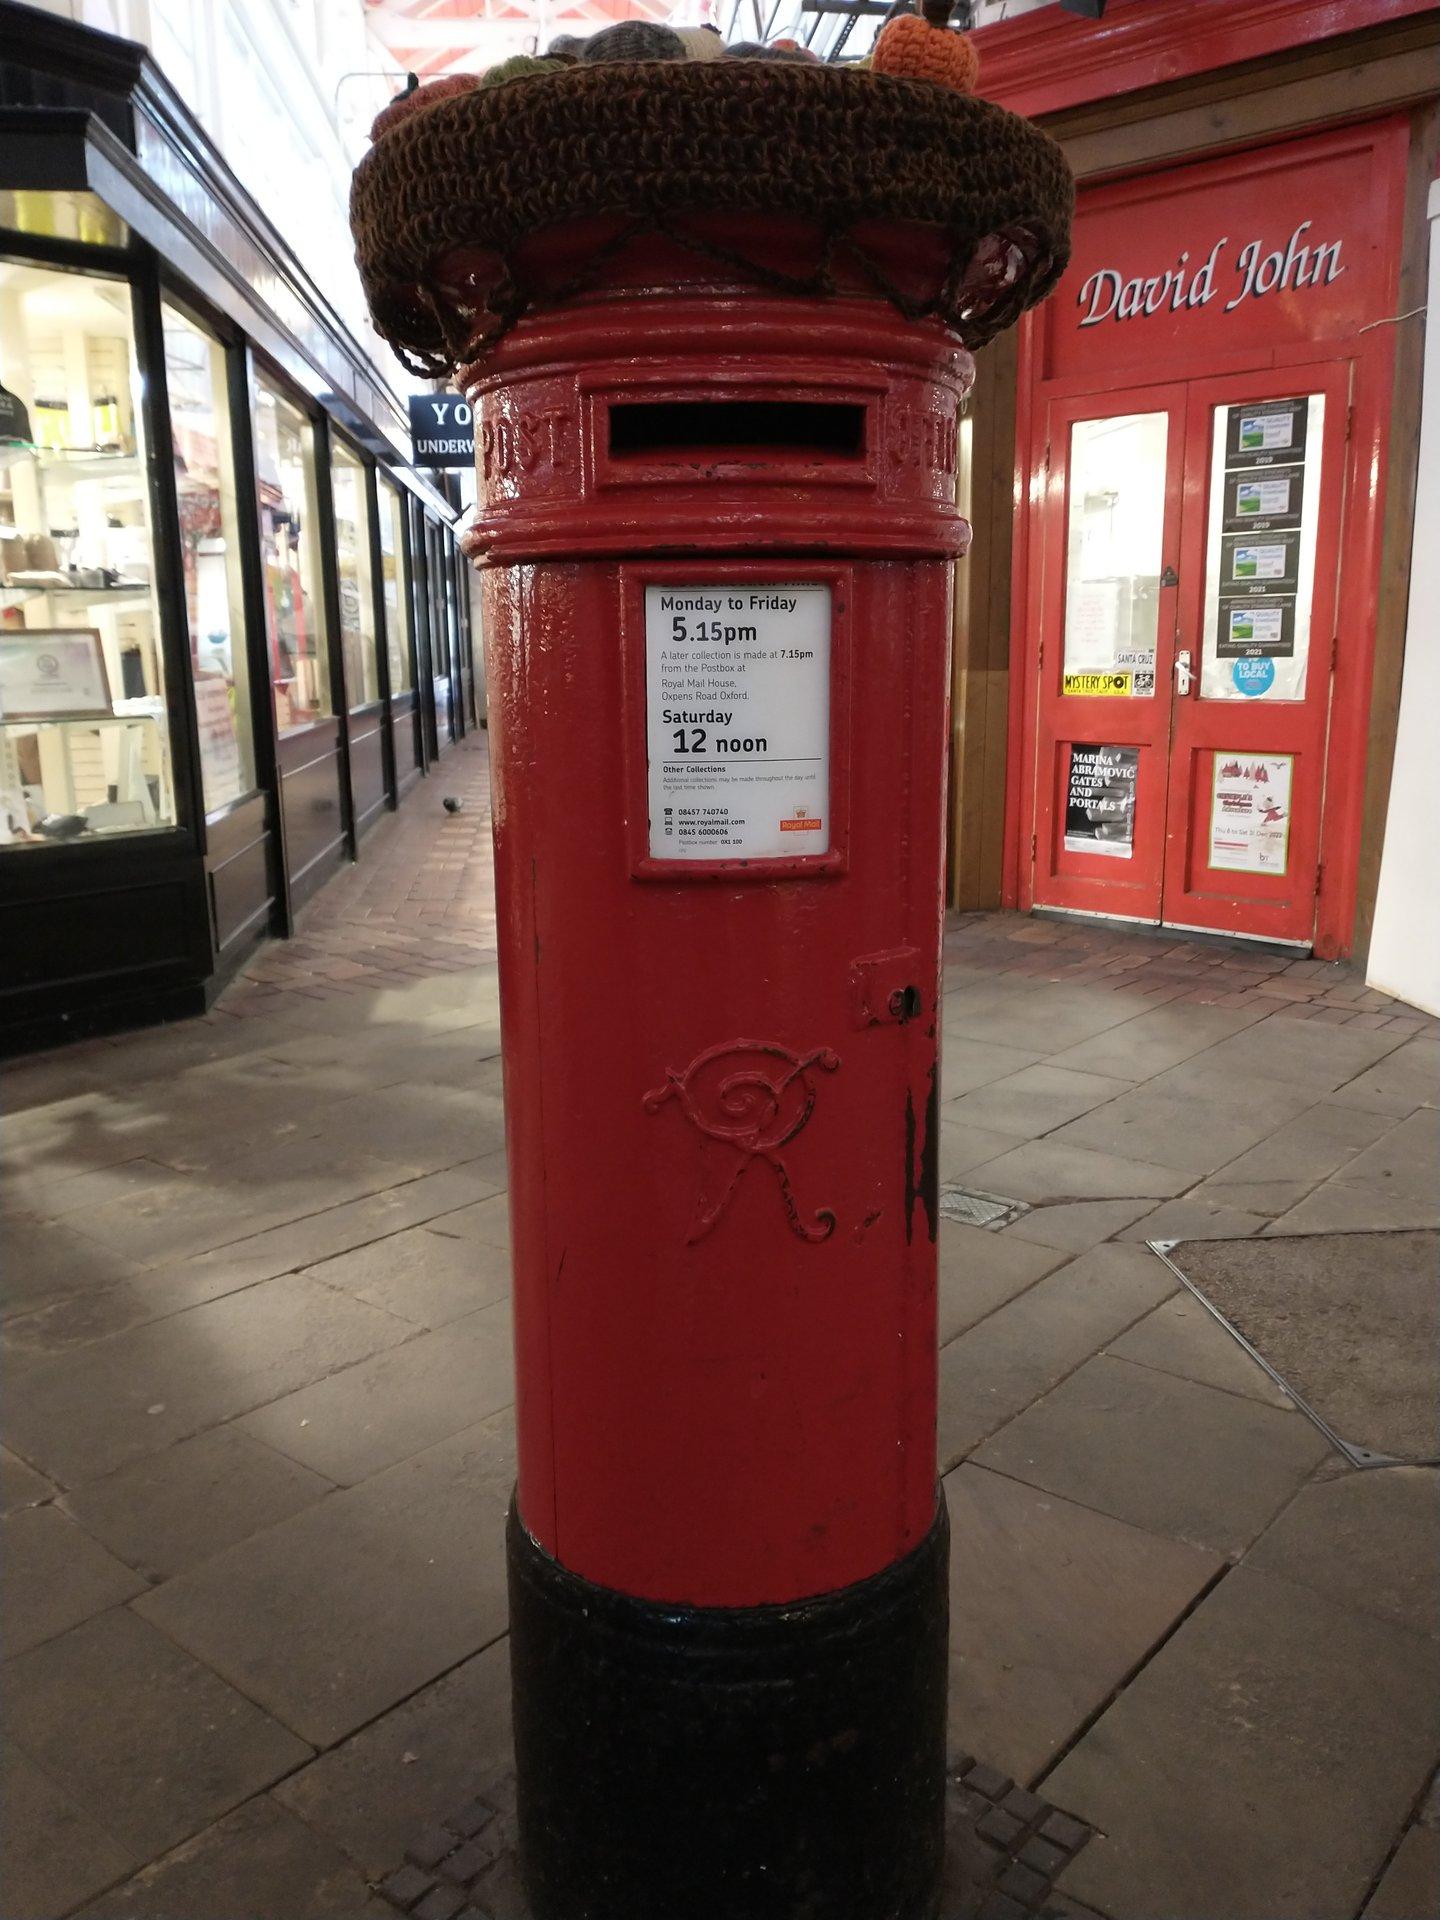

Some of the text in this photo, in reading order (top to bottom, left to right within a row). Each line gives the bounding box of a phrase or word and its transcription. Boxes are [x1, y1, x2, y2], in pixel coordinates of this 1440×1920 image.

[1077, 220, 1346, 329] David John
[661, 595, 797, 613] Monday to Friday
[672, 616, 757, 645] 5.15pm
[661, 649, 814, 661] A later collection is made at 7.15pm
[1245, 648, 1262, 656] 2021
[1118, 653, 1153, 664] SANTA CRUZ
[661, 663, 746, 673] from the Postbox at
[1238, 662, 1271, 671] TO BUY
[1239, 670, 1268, 679] LOCAL
[662, 679, 685, 690] Royal
[687, 678, 705, 688] Mail
[1065, 675, 1129, 689] MYSTERY SPOT
[662, 691, 693, 702] Oxpens
[696, 691, 717, 701] Road
[662, 709, 733, 726] Saturday
[672, 728, 767, 754] 12 noon
[1073, 753, 1114, 765] MARINA
[663, 765, 726, 773] Other Collections
[1071, 765, 1135, 779] ABRAMOVIĆ
[1071, 775, 1103, 787] GATES
[1070, 787, 1093, 797] AND
[1069, 797, 1116, 811] PORTALS
[678, 808, 729, 816] 08457 740740
[678, 818, 746, 827] www.royalmail.com
[782, 820, 820, 831] Royal Mail
[678, 828, 729, 836] 0845 6000606
